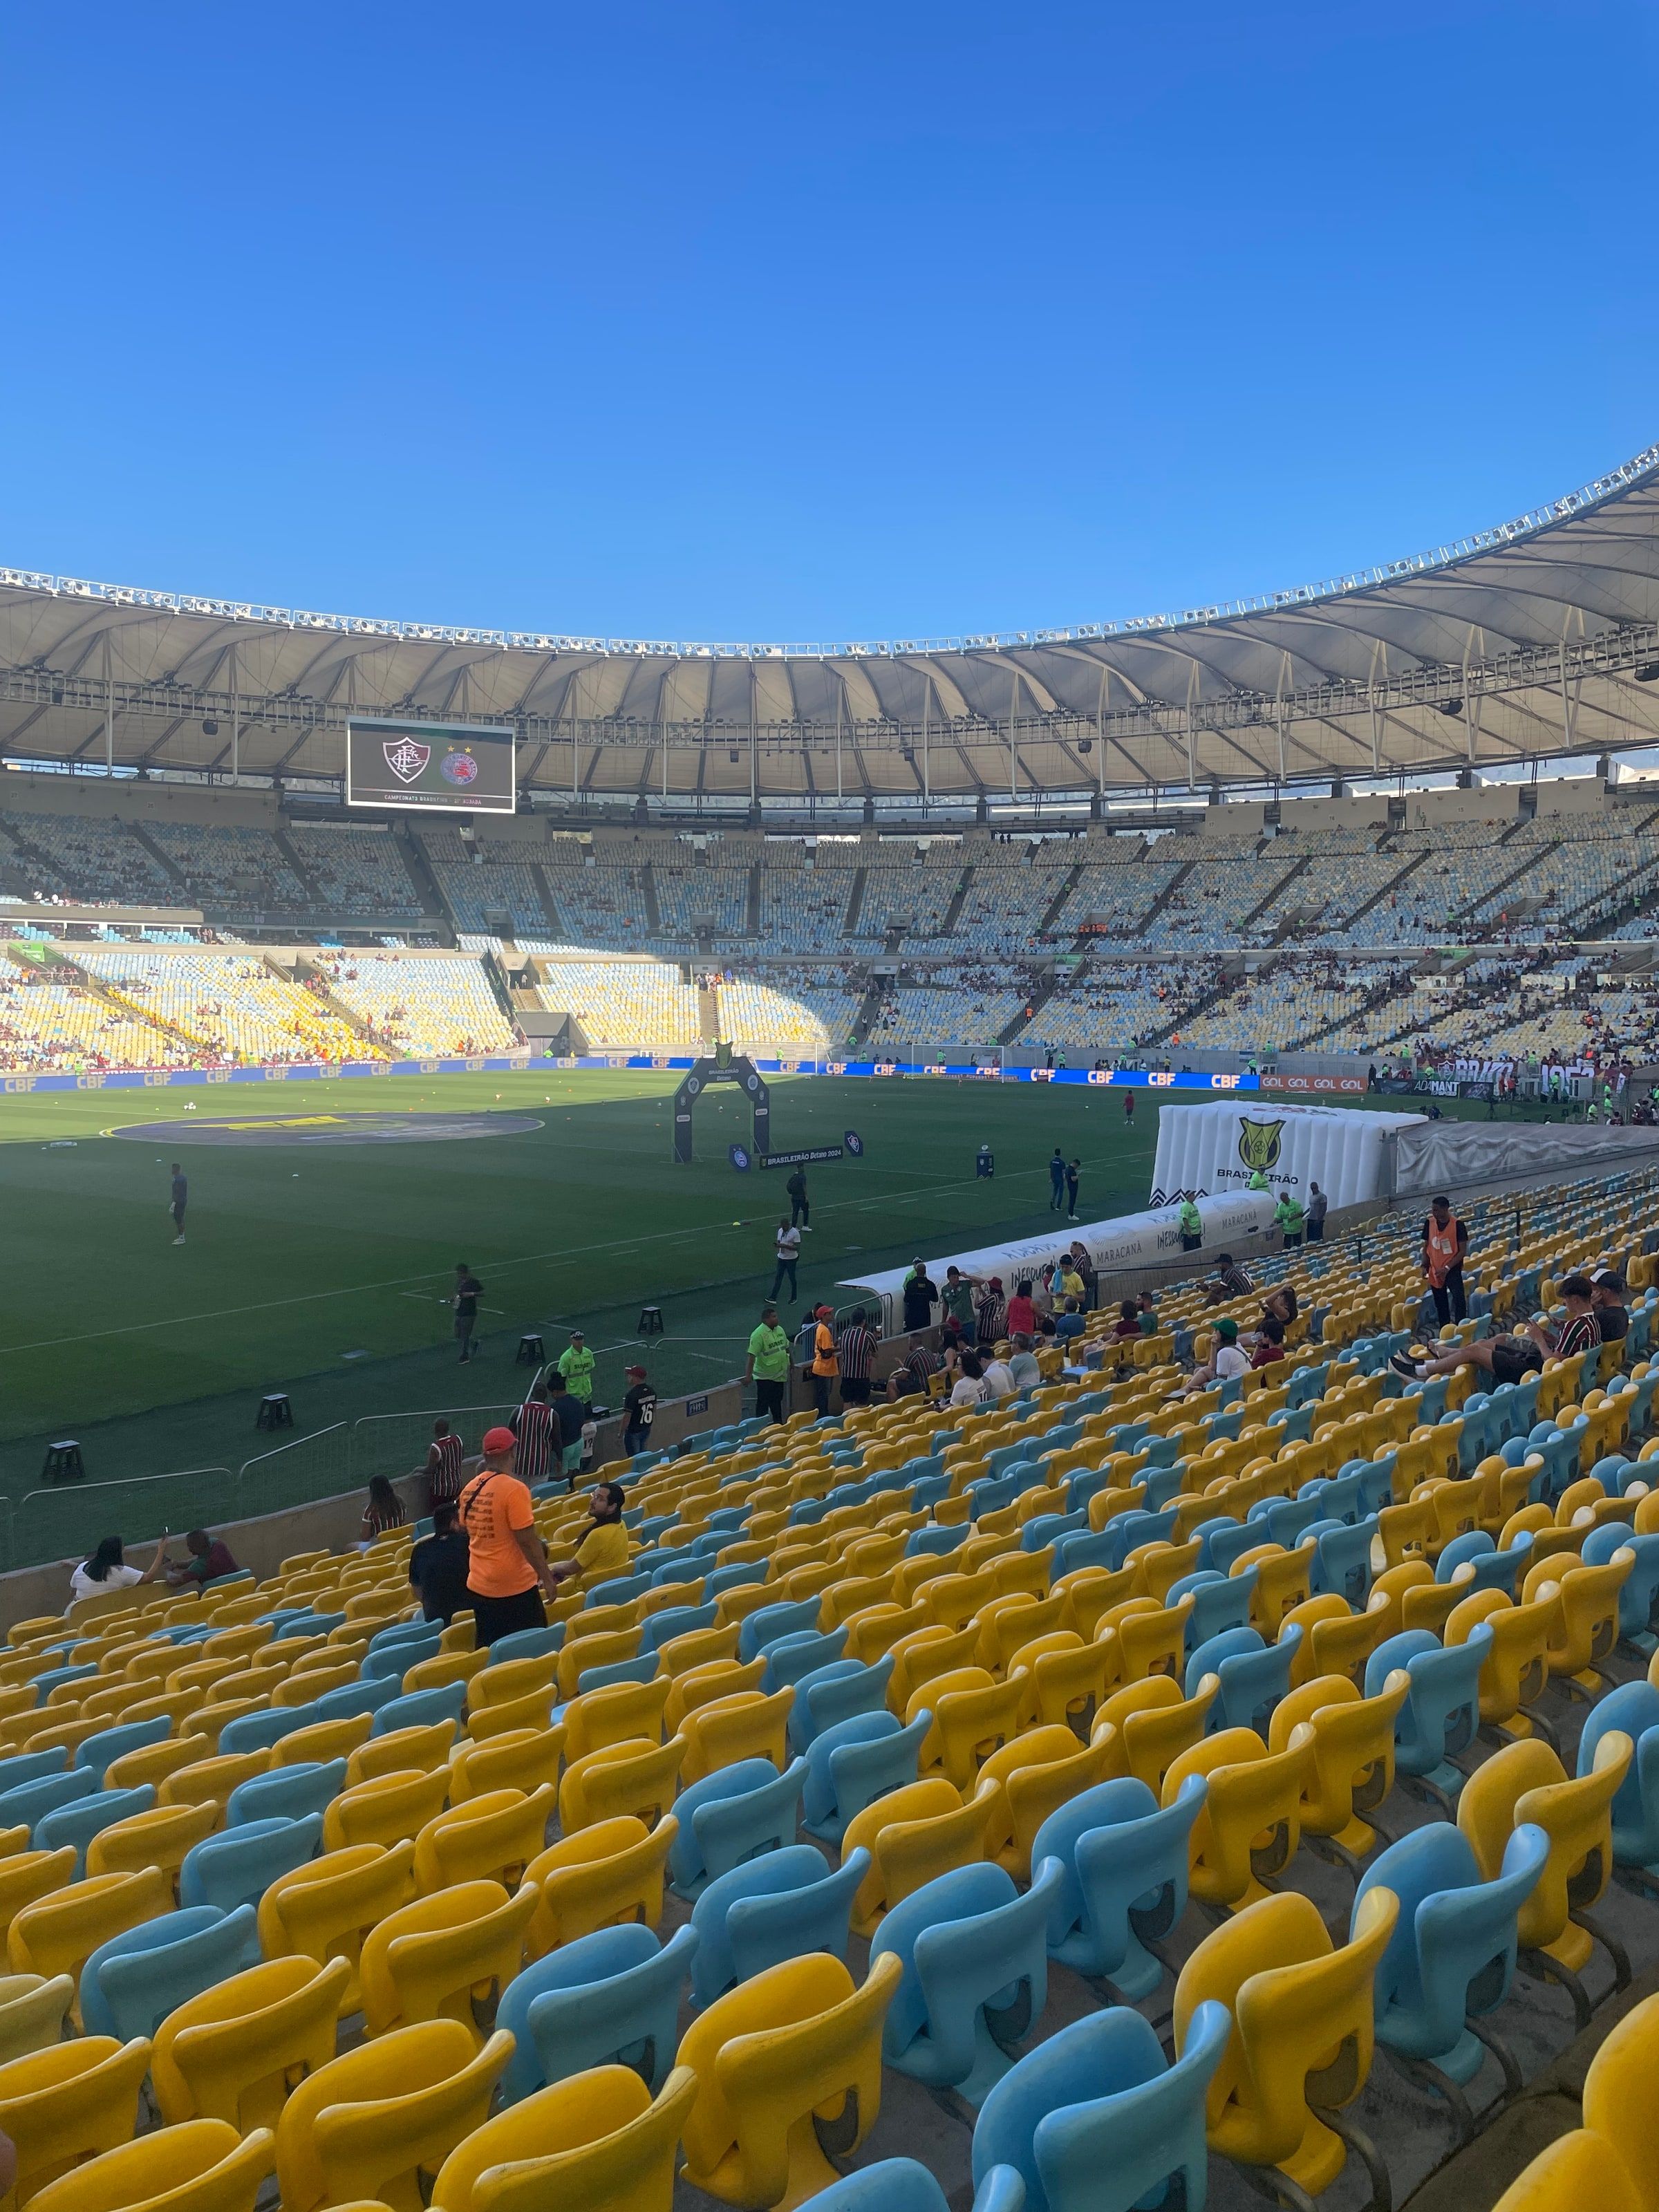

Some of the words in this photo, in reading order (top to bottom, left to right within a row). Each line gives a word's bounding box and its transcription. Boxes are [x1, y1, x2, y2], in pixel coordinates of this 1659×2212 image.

[233, 914, 254, 924] CASA
[5, 1078, 37, 1093] CBF
[77, 1075, 106, 1089] CBF
[144, 1072, 172, 1087] CBF
[207, 1070, 232, 1083] CBF
[265, 1068, 289, 1080] CBF
[319, 1065, 343, 1078] CBF
[371, 1063, 393, 1076] CBF
[420, 1061, 440, 1074] CBF
[466, 1060, 485, 1071] CBF
[509, 1059, 530, 1070] CBF
[556, 1058, 579, 1068] CBF
[608, 1058, 629, 1068] CBF
[652, 1058, 671, 1068] CBF
[780, 1062, 800, 1072] CBF
[826, 1062, 847, 1074] CBF
[874, 1064, 897, 1076] CBF
[1087, 1071, 1115, 1084] CBF
[1147, 1072, 1177, 1086] CBF
[1211, 1074, 1241, 1089] CBF
[708, 1067, 740, 1076] BRASILEIRÃO
[1262, 1077, 1284, 1087] GOL
[1288, 1078, 1310, 1088] GOL
[1314, 1078, 1336, 1089] GOL
[1340, 1080, 1363, 1090] GOL
[1414, 1080, 1460, 1092] ADAMANT
[767, 1153, 809, 1165] BRASILEIRÃO
[1217, 1168, 1299, 1185] BRASIIRÃO
[1221, 1209, 1257, 1230] MARACANÃ
[1096, 1240, 1143, 1264] MARACANÃ
[639, 1403, 653, 1425] 16
